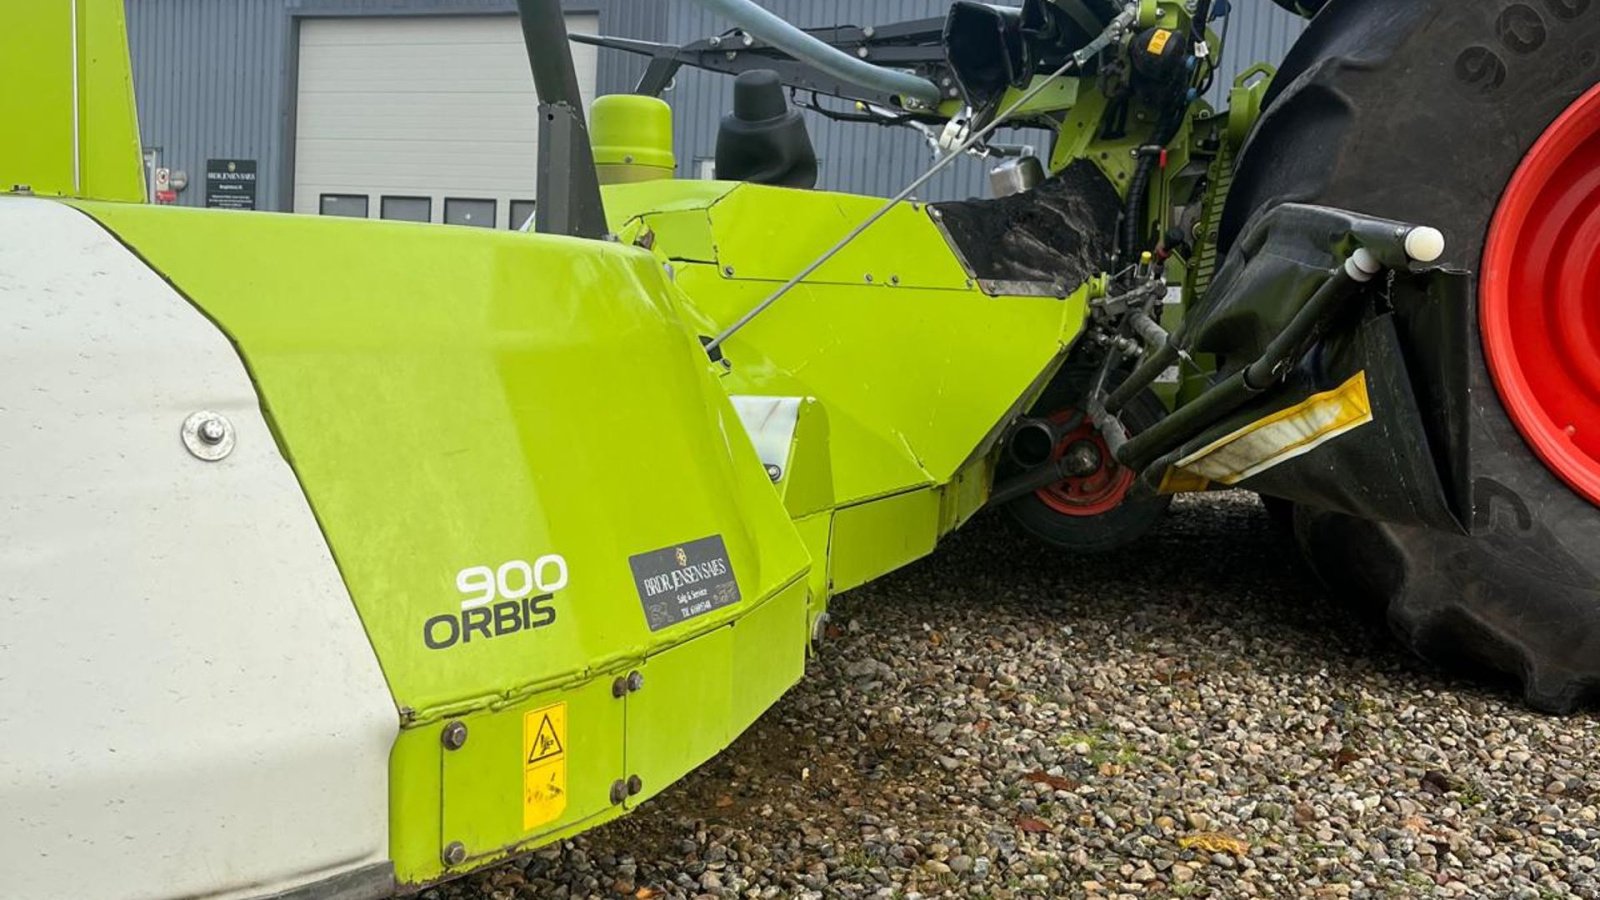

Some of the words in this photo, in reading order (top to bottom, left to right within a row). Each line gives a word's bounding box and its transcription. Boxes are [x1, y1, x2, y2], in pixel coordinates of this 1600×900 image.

[456, 553, 568, 611] 900
[671, 564, 702, 592] JENSEN
[424, 593, 556, 650] ORBIS
